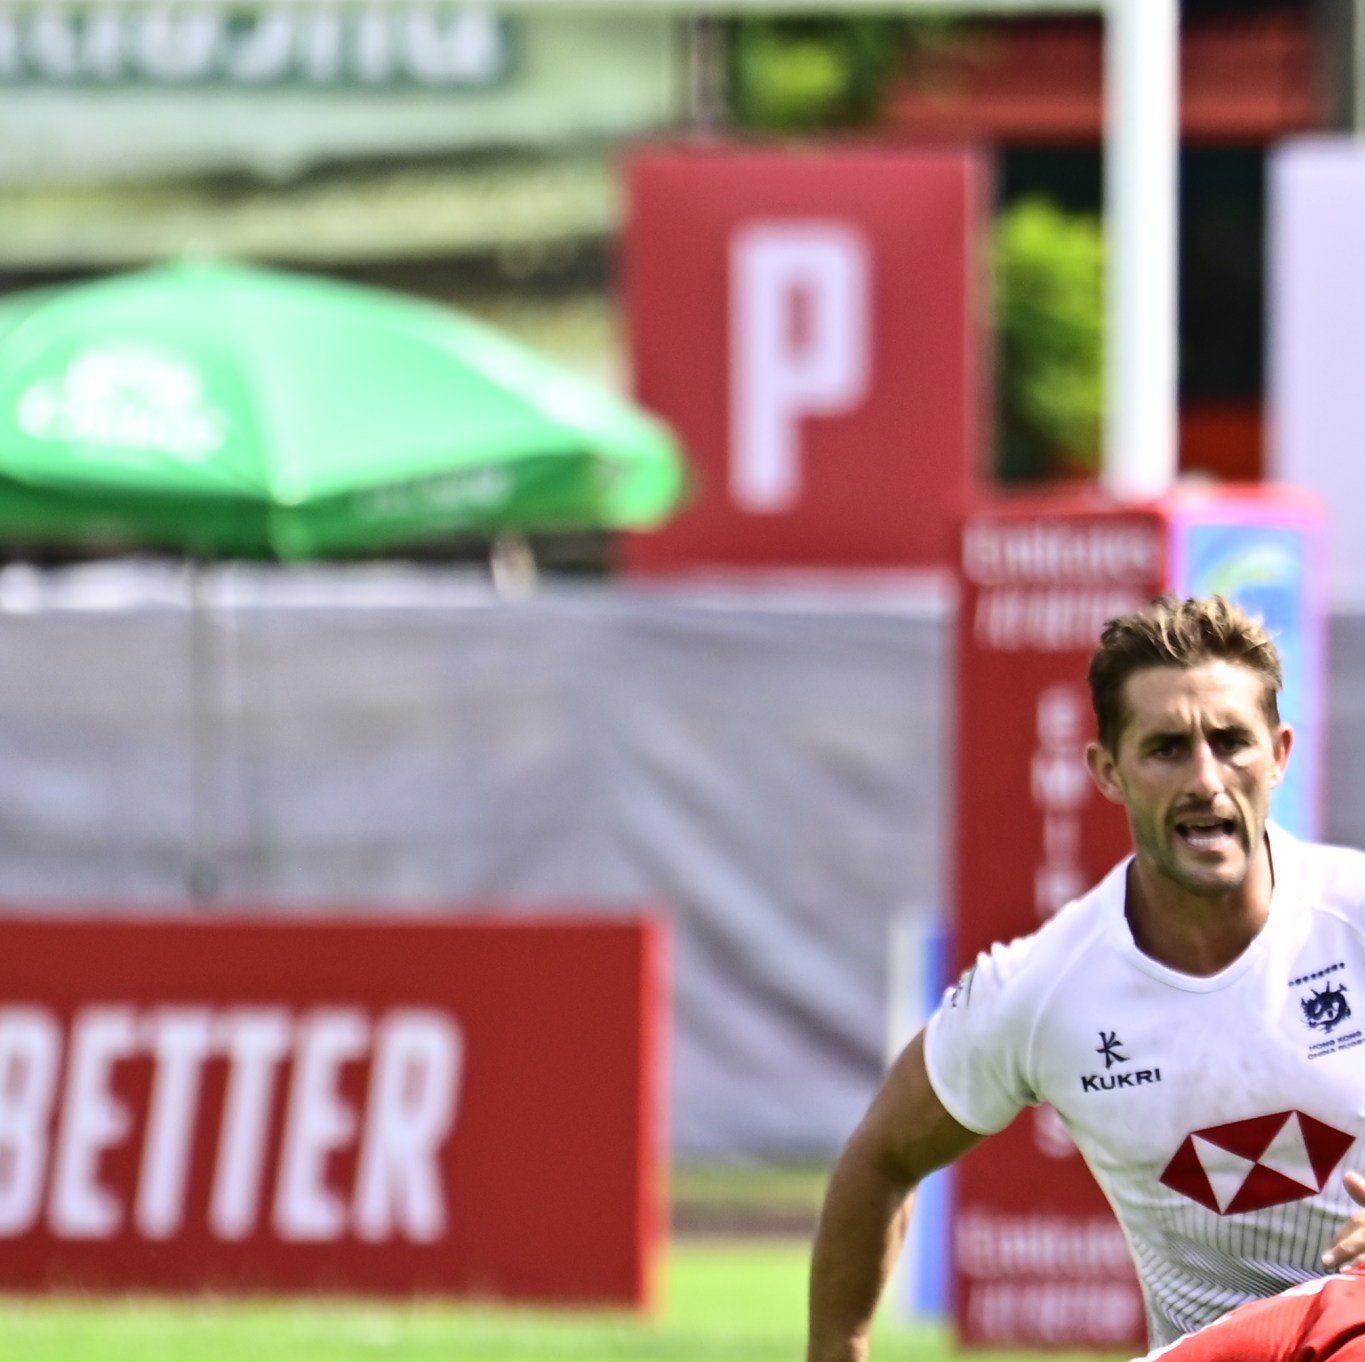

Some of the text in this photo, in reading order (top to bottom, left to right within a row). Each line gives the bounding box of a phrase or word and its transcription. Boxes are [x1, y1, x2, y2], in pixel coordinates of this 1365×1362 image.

[730, 221, 871, 514] P
[0, 1005, 464, 1243] BETTER
[1081, 1068, 1162, 1093] KUKRI
